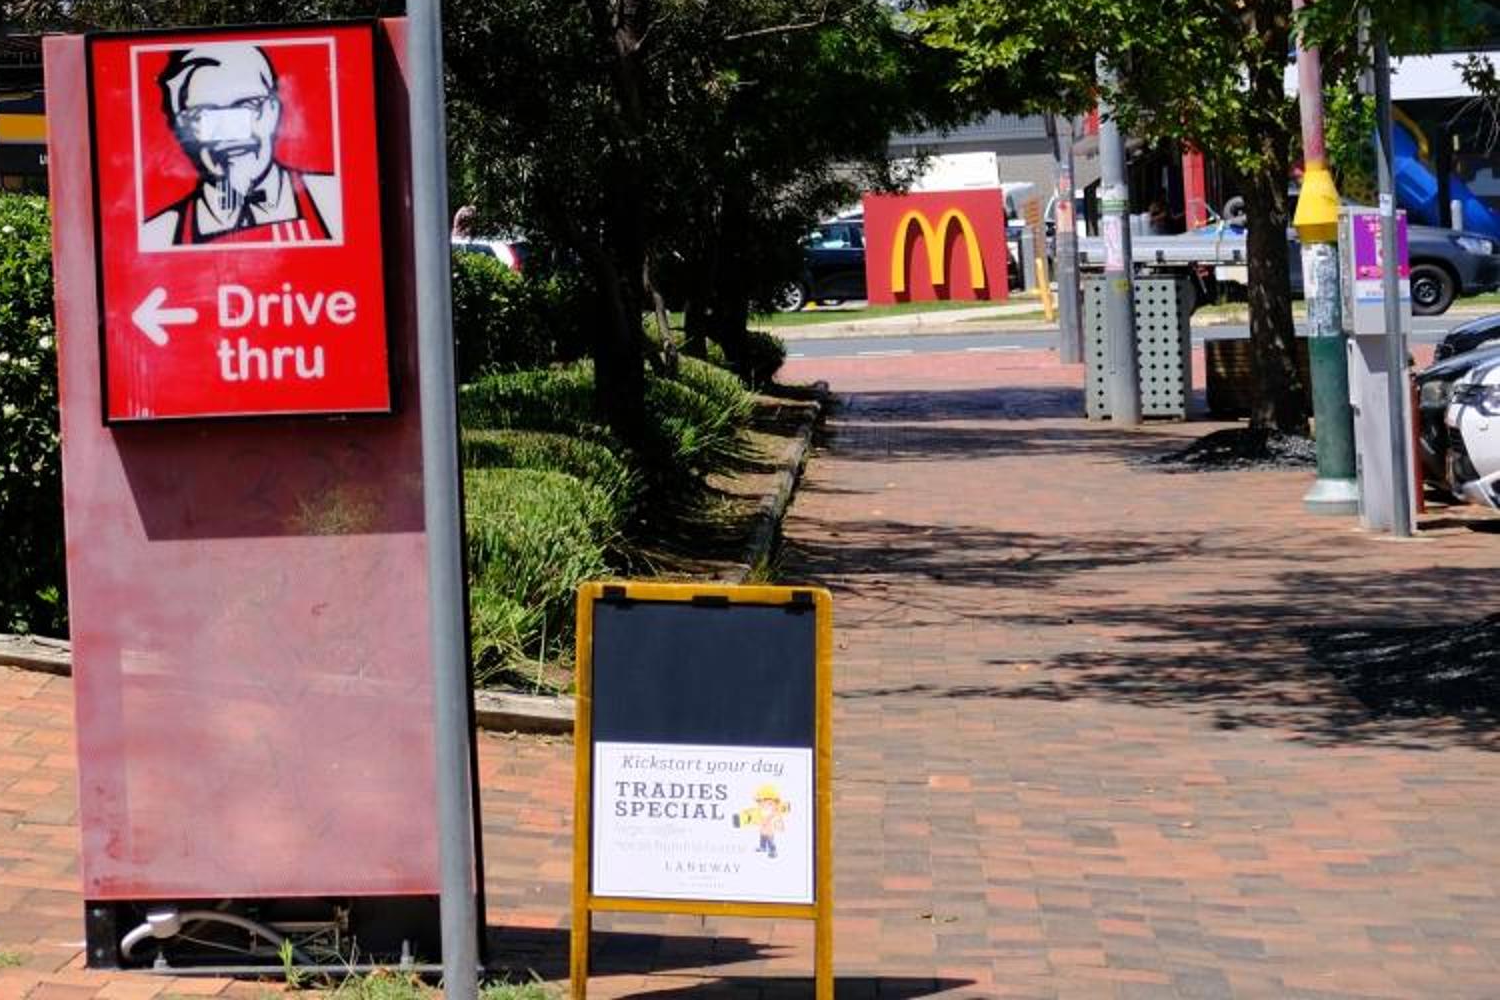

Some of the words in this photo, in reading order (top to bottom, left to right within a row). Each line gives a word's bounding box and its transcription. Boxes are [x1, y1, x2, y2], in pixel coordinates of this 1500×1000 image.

[217, 282, 357, 329] Drive
[216, 337, 325, 382] thru
[622, 754, 702, 772] Kickstart
[706, 760, 746, 775] your
[751, 757, 785, 777] day
[615, 780, 729, 801] TRADIES
[614, 800, 726, 821] SPECIAL
